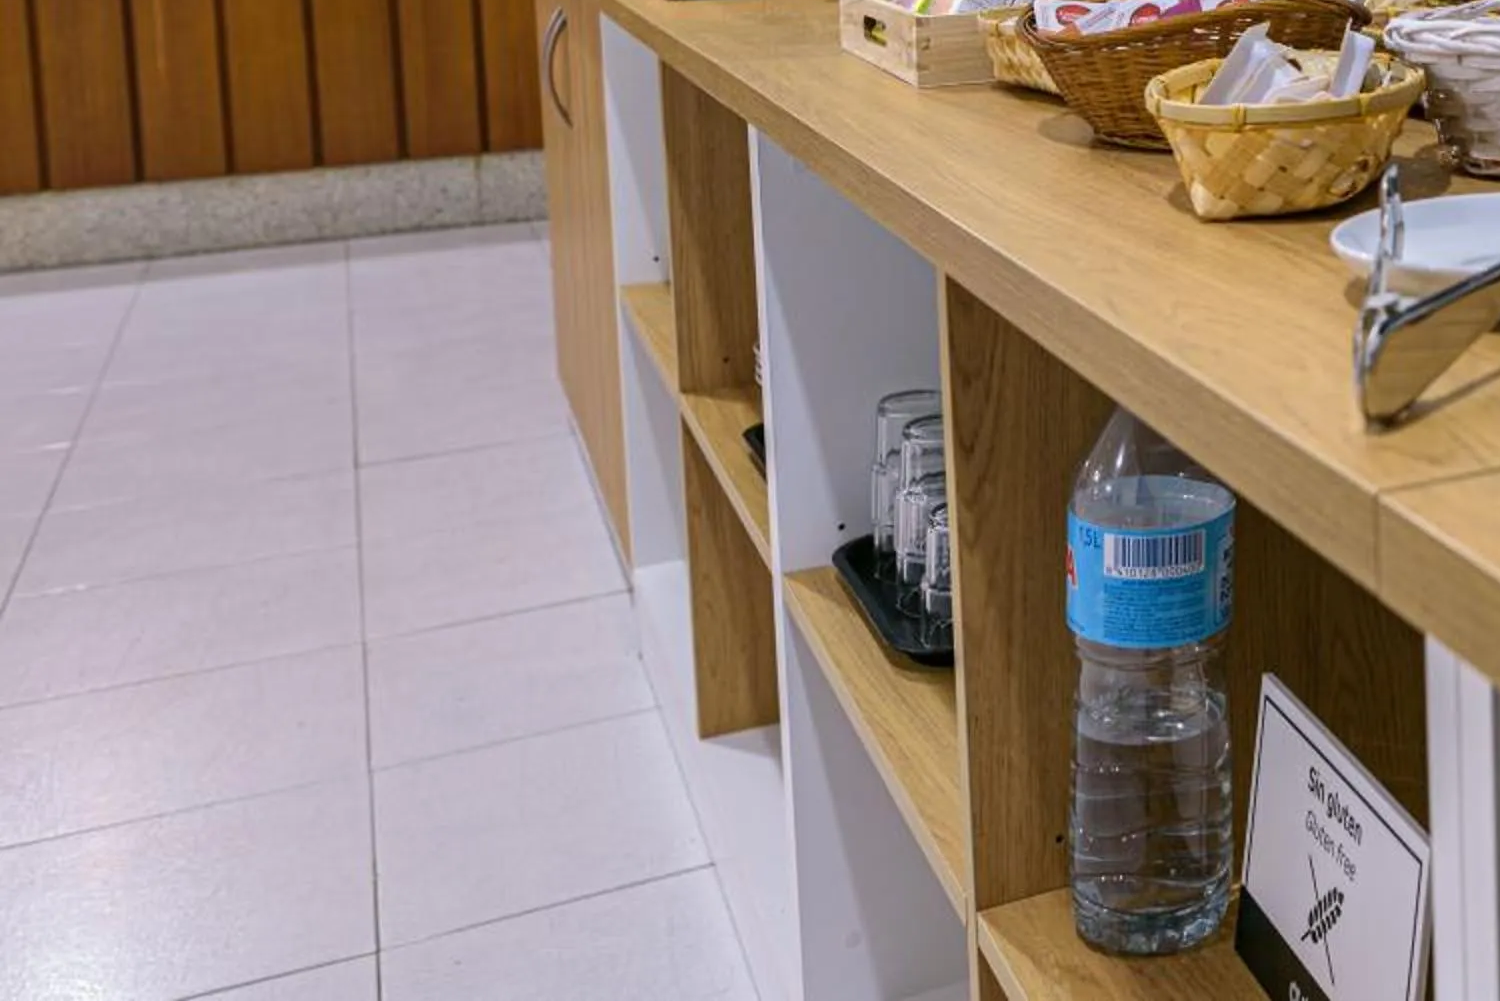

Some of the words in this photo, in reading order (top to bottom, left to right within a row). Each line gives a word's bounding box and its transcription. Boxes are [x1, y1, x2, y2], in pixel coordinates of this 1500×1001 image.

[1307, 766, 1325, 804] Sin
[1326, 792, 1363, 847] gluten
[1305, 810, 1335, 857] Gluten
[1335, 842, 1357, 882] free
